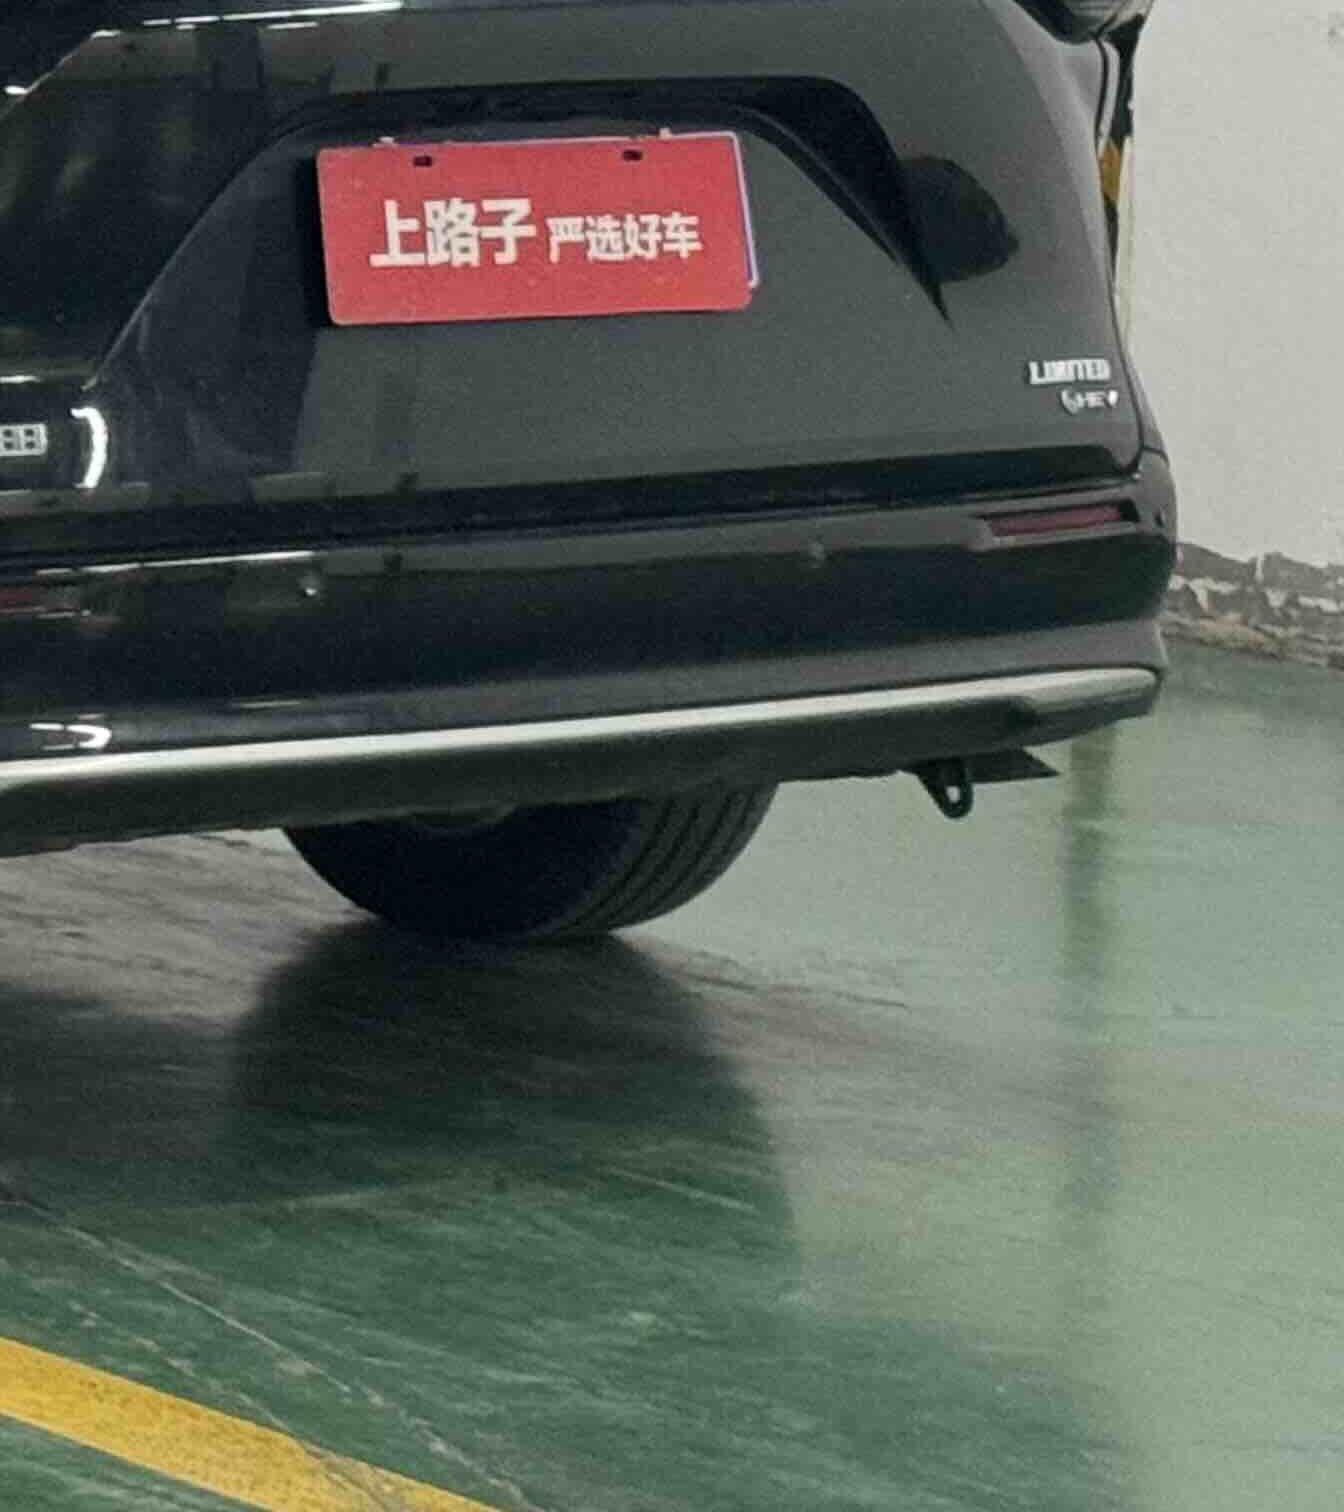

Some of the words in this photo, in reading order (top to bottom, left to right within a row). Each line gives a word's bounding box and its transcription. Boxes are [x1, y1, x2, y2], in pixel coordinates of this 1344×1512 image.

[369, 198, 537, 268] 上路子
[547, 212, 703, 263] 严选好车
